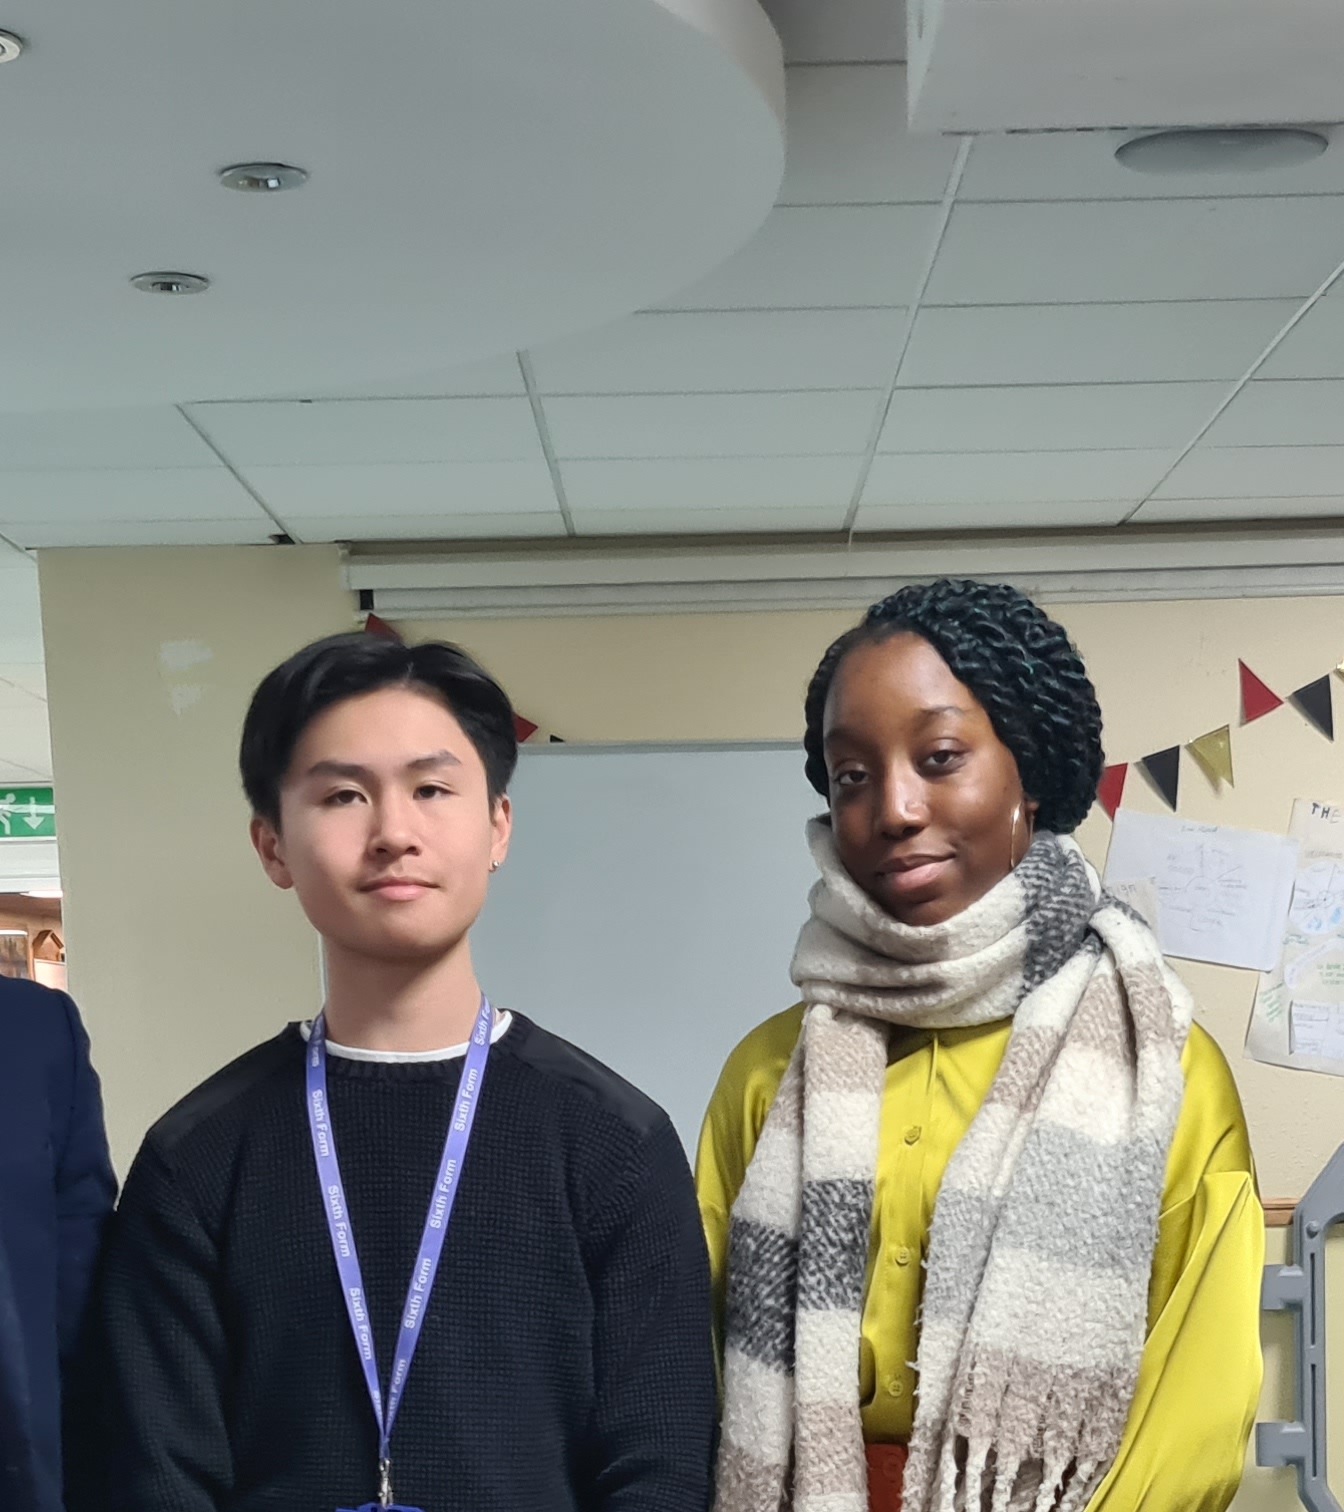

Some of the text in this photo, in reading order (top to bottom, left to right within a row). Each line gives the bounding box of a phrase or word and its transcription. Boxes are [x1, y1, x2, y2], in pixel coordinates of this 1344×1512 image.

[1312, 802, 1341, 824] THE
[312, 1089, 330, 1157] Sixth Form
[454, 1068, 478, 1132] Sixth Form
[328, 1185, 350, 1258] Sixth Form
[430, 1159, 457, 1229] Sixth Form
[349, 1287, 372, 1361] Sixth Form
[405, 1257, 432, 1330] Sixth Form
